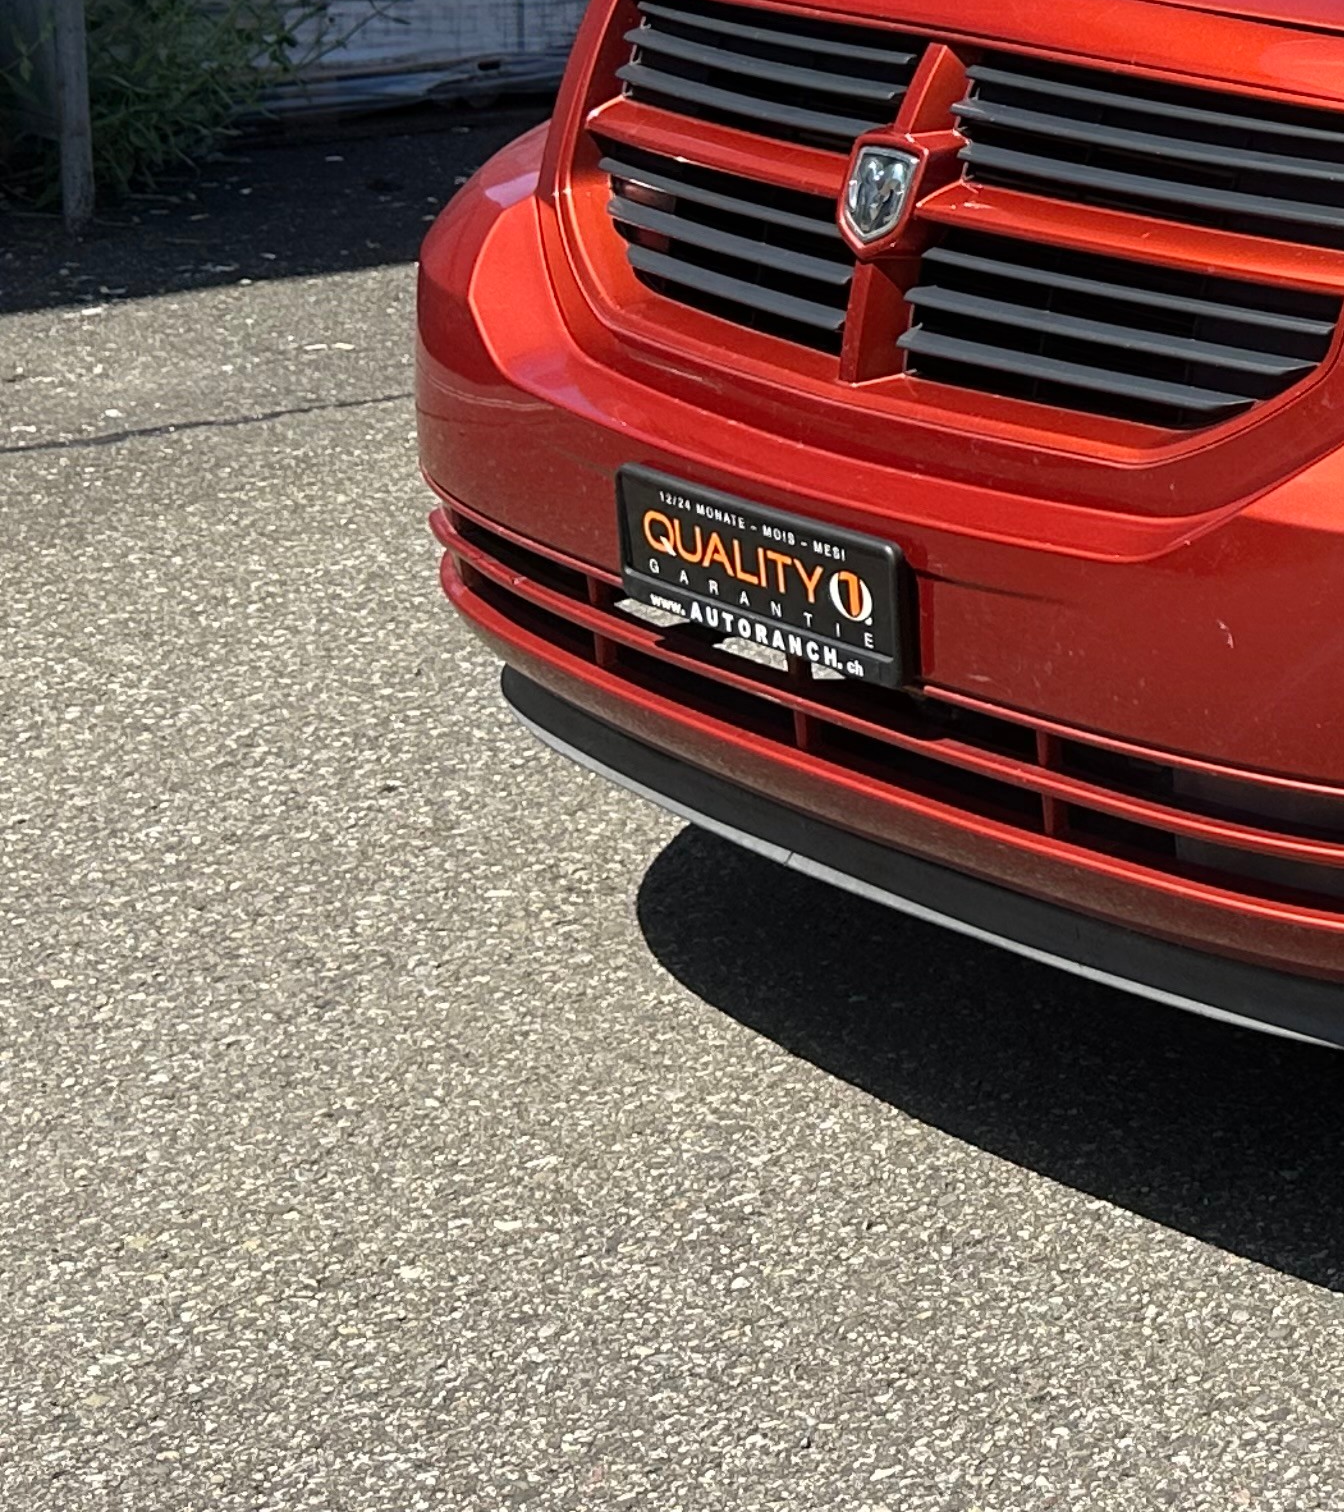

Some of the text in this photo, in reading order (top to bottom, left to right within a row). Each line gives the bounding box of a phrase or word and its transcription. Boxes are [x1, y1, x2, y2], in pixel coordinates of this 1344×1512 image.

[642, 509, 824, 604] QUALITY
[659, 491, 691, 512] 12/24
[696, 503, 746, 530] MONATE
[762, 524, 796, 547] MOIS
[813, 540, 846, 562] MESI
[649, 558, 874, 649] GARANTIE
